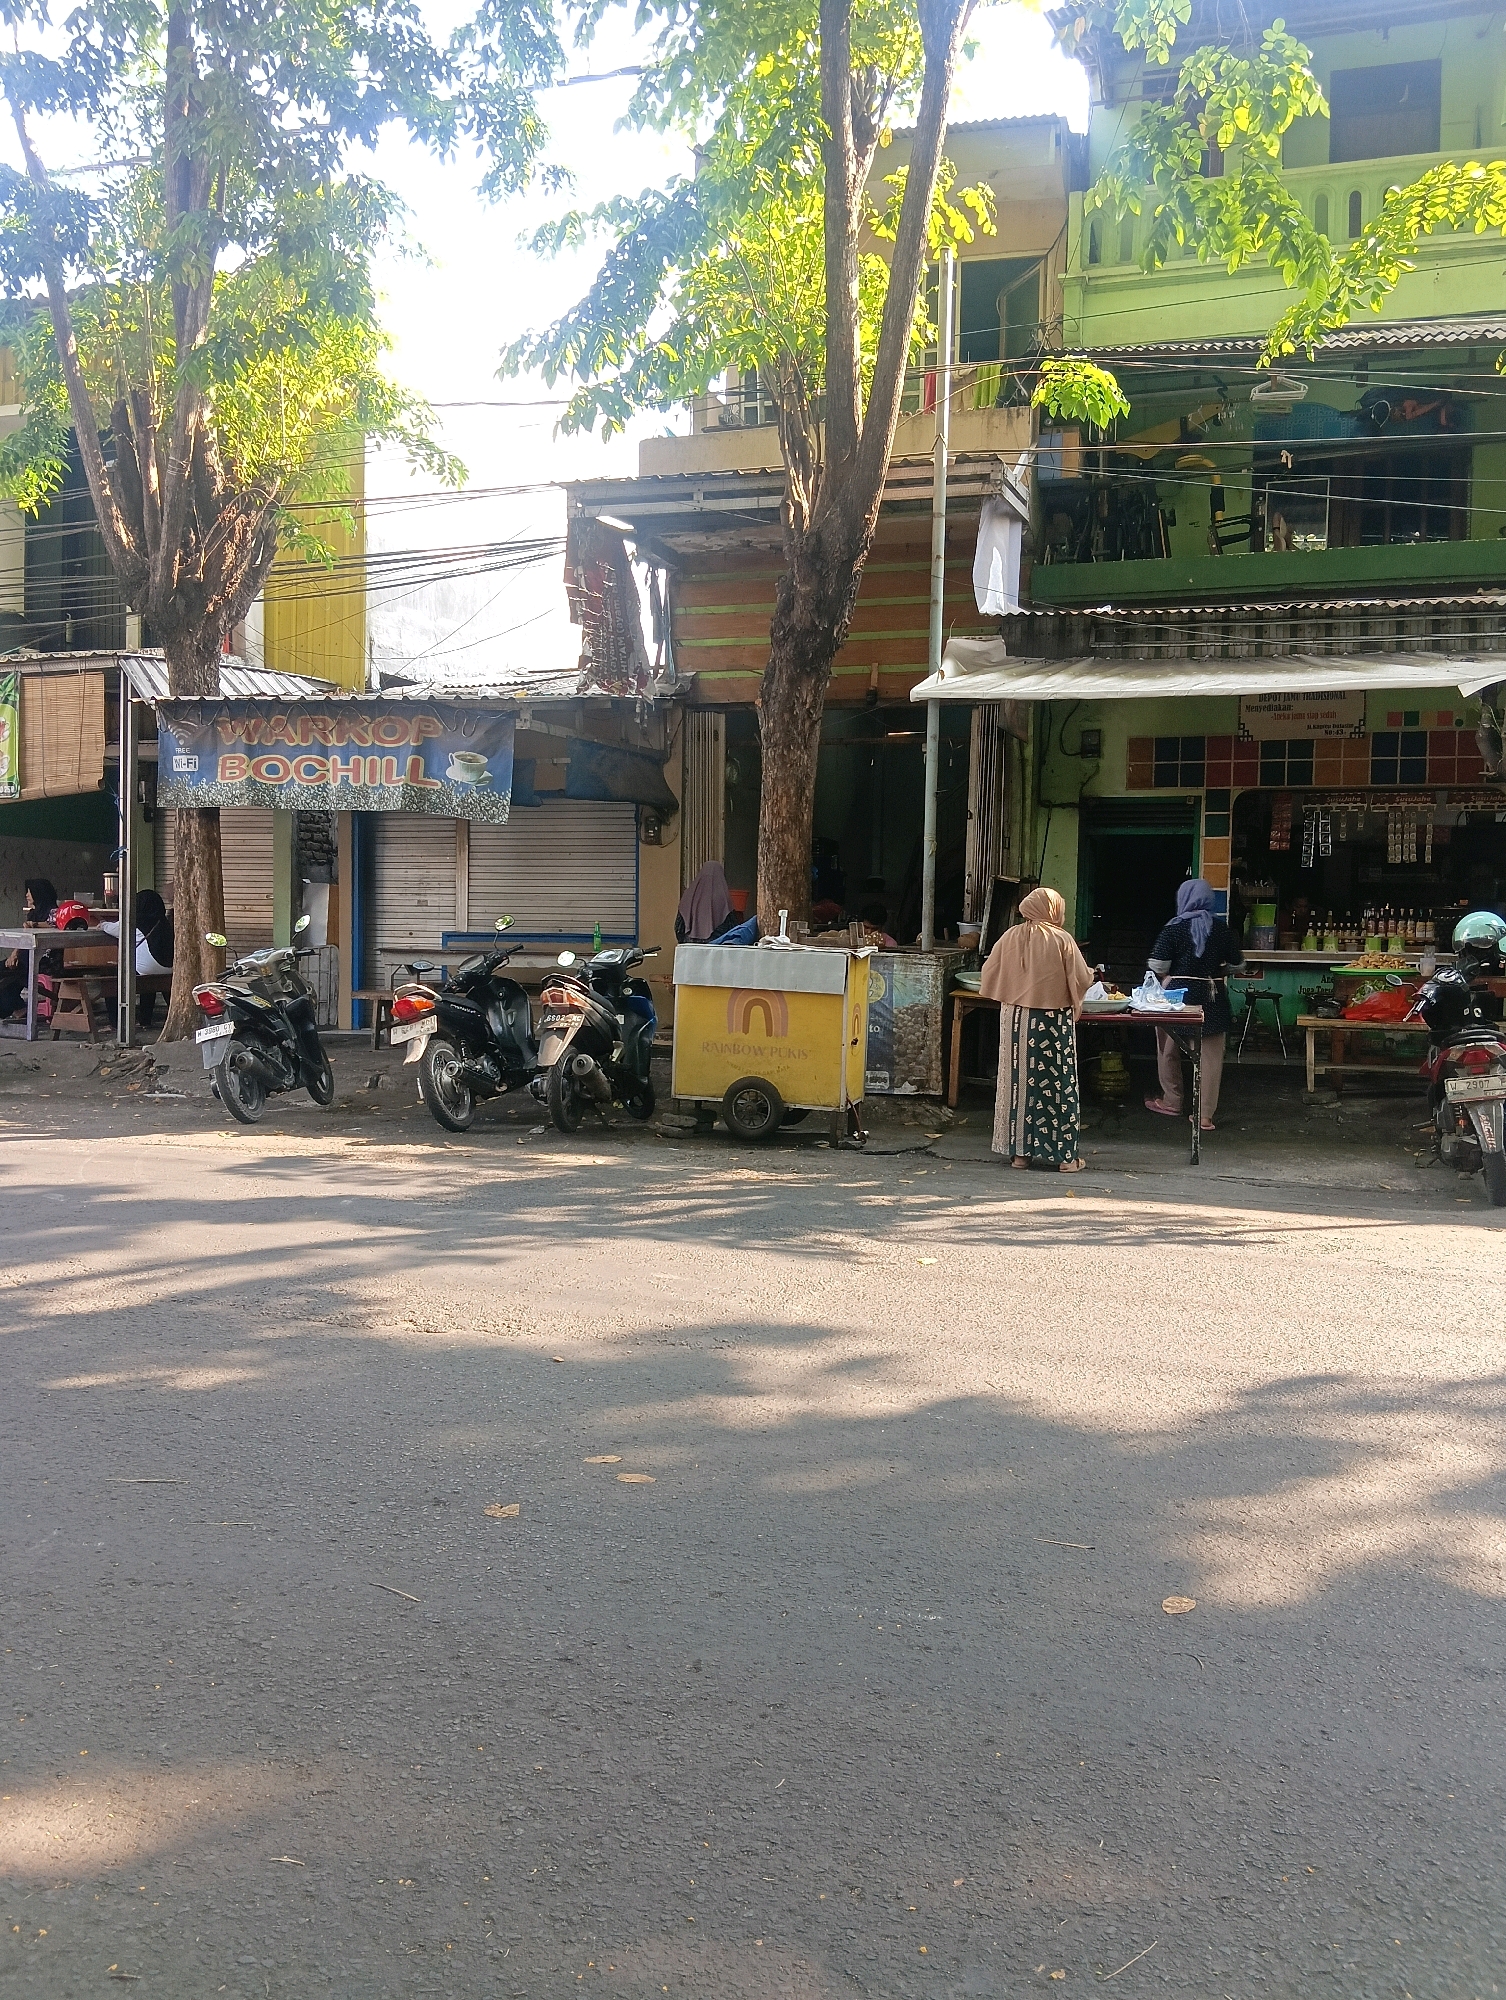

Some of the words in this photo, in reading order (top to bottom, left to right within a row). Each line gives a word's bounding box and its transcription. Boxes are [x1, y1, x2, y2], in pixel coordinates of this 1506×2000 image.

[616, 637, 629, 673] HITAM
[217, 714, 444, 747] WARKOP
[217, 754, 442, 789] BOCHILL
[702, 1041, 765, 1056] RAINBOW
[769, 1046, 809, 1060] PUKIS
[1465, 1080, 1490, 1090] 2907
